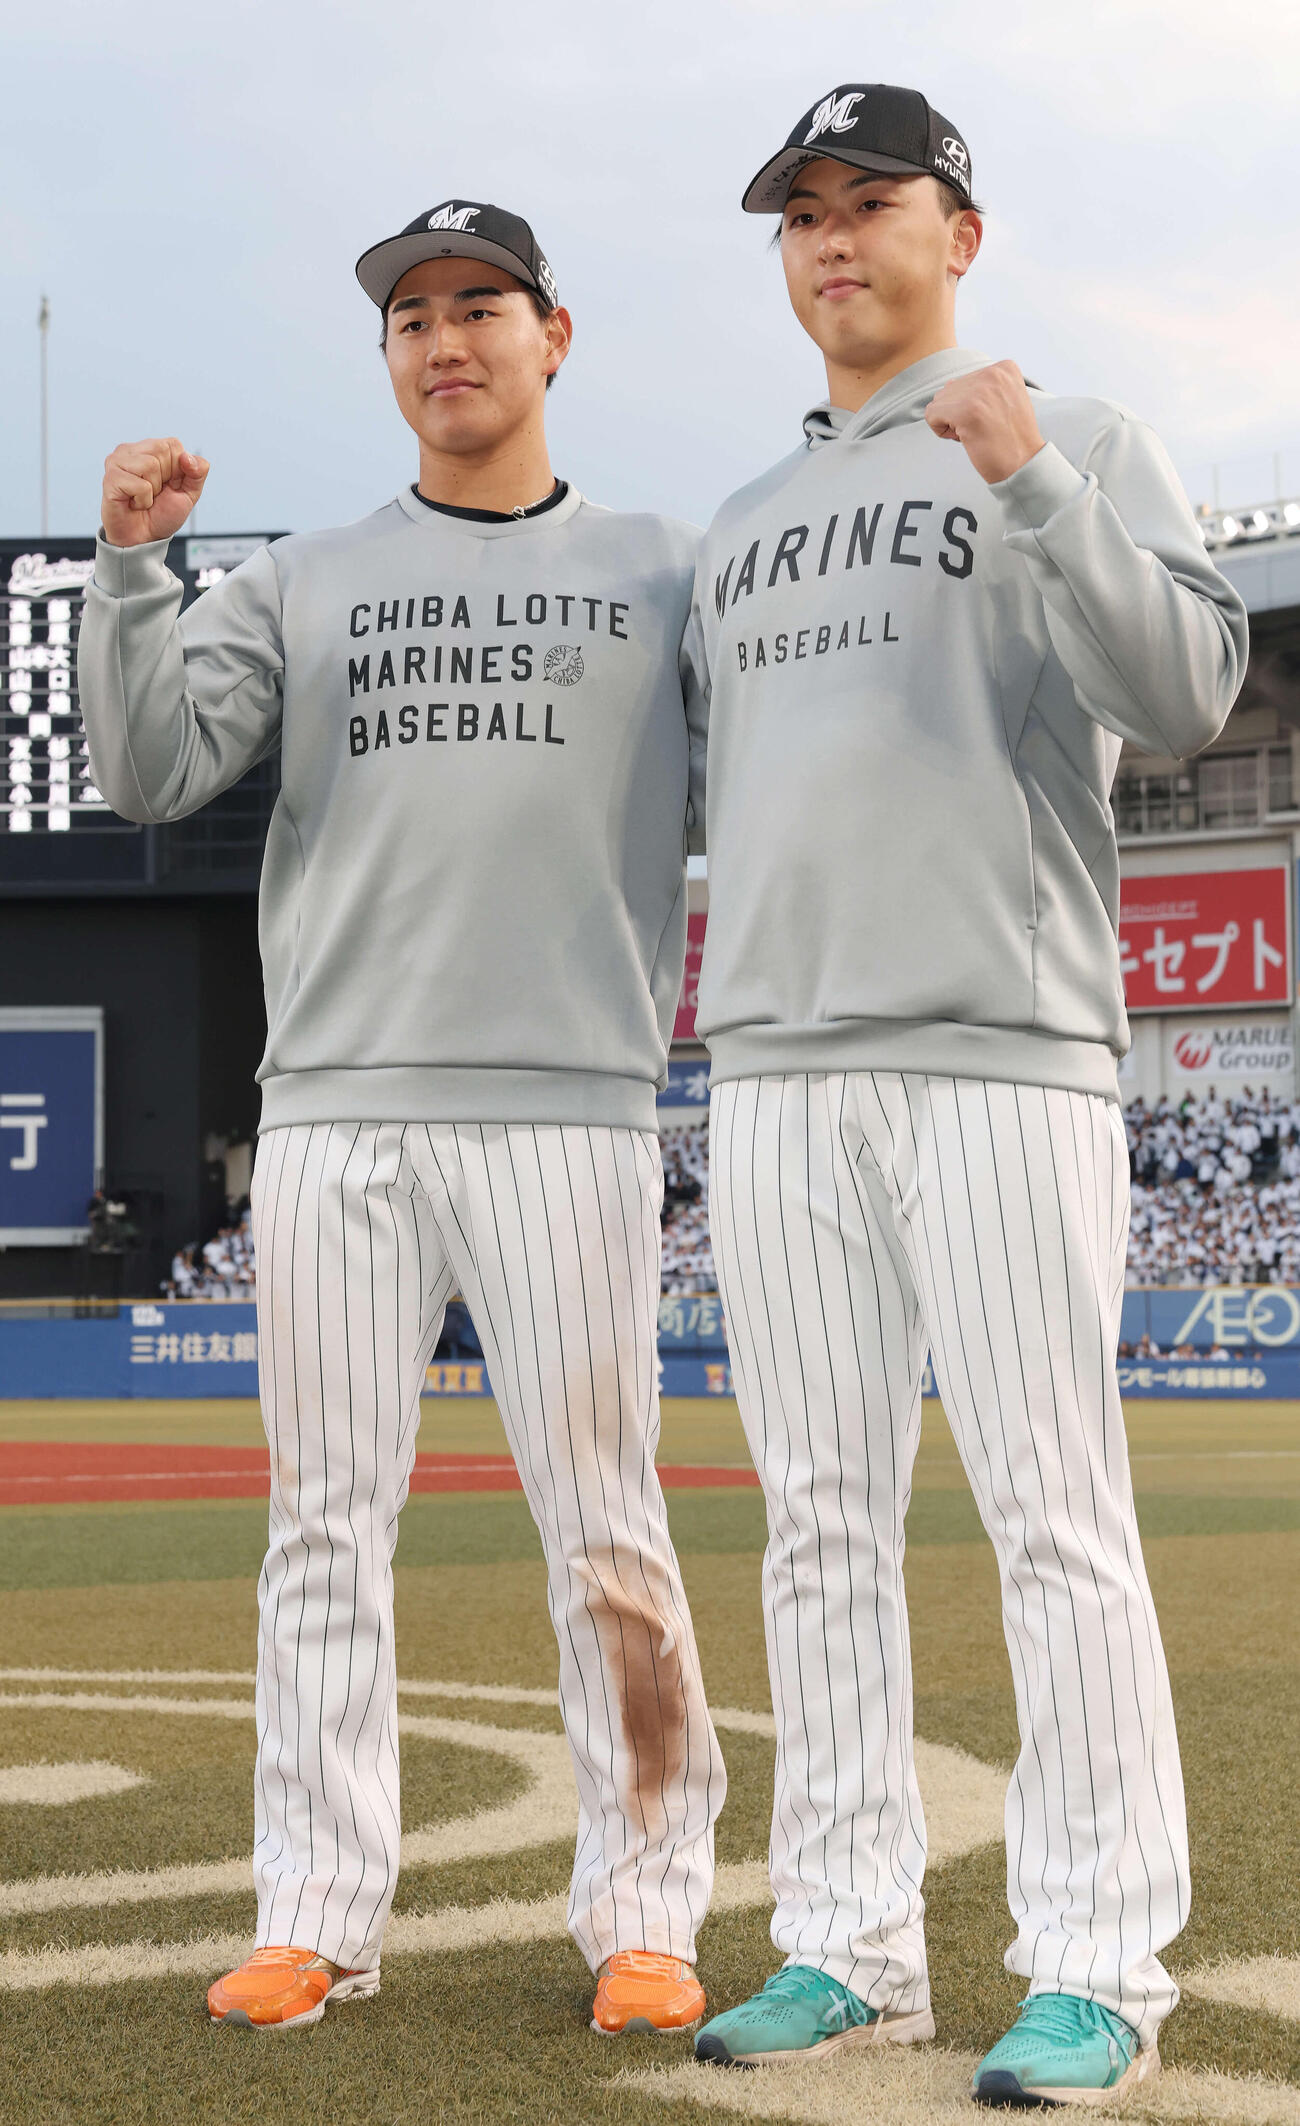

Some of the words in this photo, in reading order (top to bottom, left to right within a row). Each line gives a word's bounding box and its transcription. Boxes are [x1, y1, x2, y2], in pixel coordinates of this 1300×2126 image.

[715, 500, 978, 622] MARINES
[349, 595, 471, 639] CHIBA
[496, 593, 630, 641] LOTTE
[737, 611, 900, 673] BASEBALL
[348, 644, 533, 698] MARINES
[348, 702, 565, 758] BASEBALL
[1218, 1049, 1291, 1070] Group
